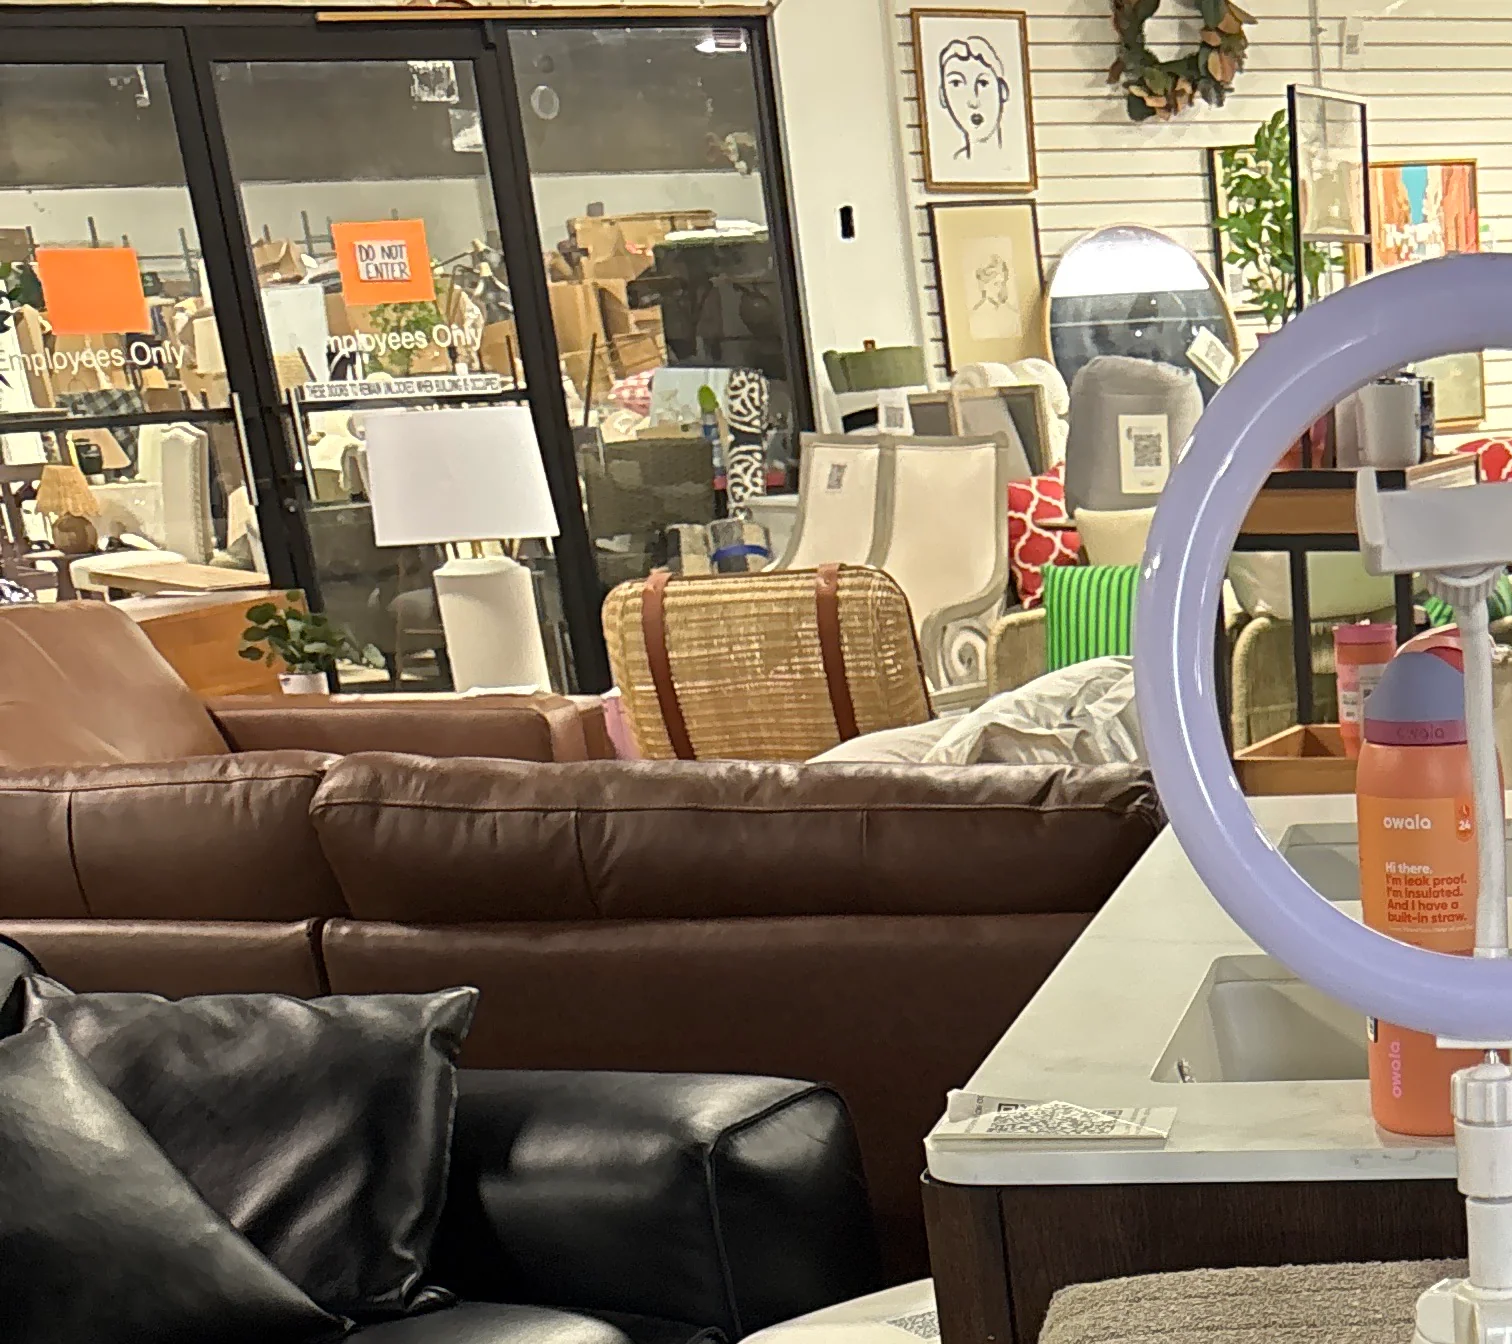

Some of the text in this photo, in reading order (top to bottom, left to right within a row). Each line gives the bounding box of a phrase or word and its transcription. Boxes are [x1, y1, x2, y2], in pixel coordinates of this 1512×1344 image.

[358, 243, 405, 262] DO NOT
[365, 262, 411, 280] ENTER
[326, 323, 482, 358] mployees Only
[130, 340, 186, 369] Only
[1383, 814, 1432, 829] owala
[1458, 820, 1471, 831] 24
[1385, 861, 1433, 874] Hi there.
[1386, 873, 1467, 888] I'm leak proof.
[1386, 885, 1463, 898] I'm insulated.
[1387, 899, 1408, 910] And
[1418, 899, 1448, 910] have
[1451, 901, 1459, 910] a
[1388, 911, 1468, 924] built-in straw.
[1388, 1041, 1403, 1098] owala
